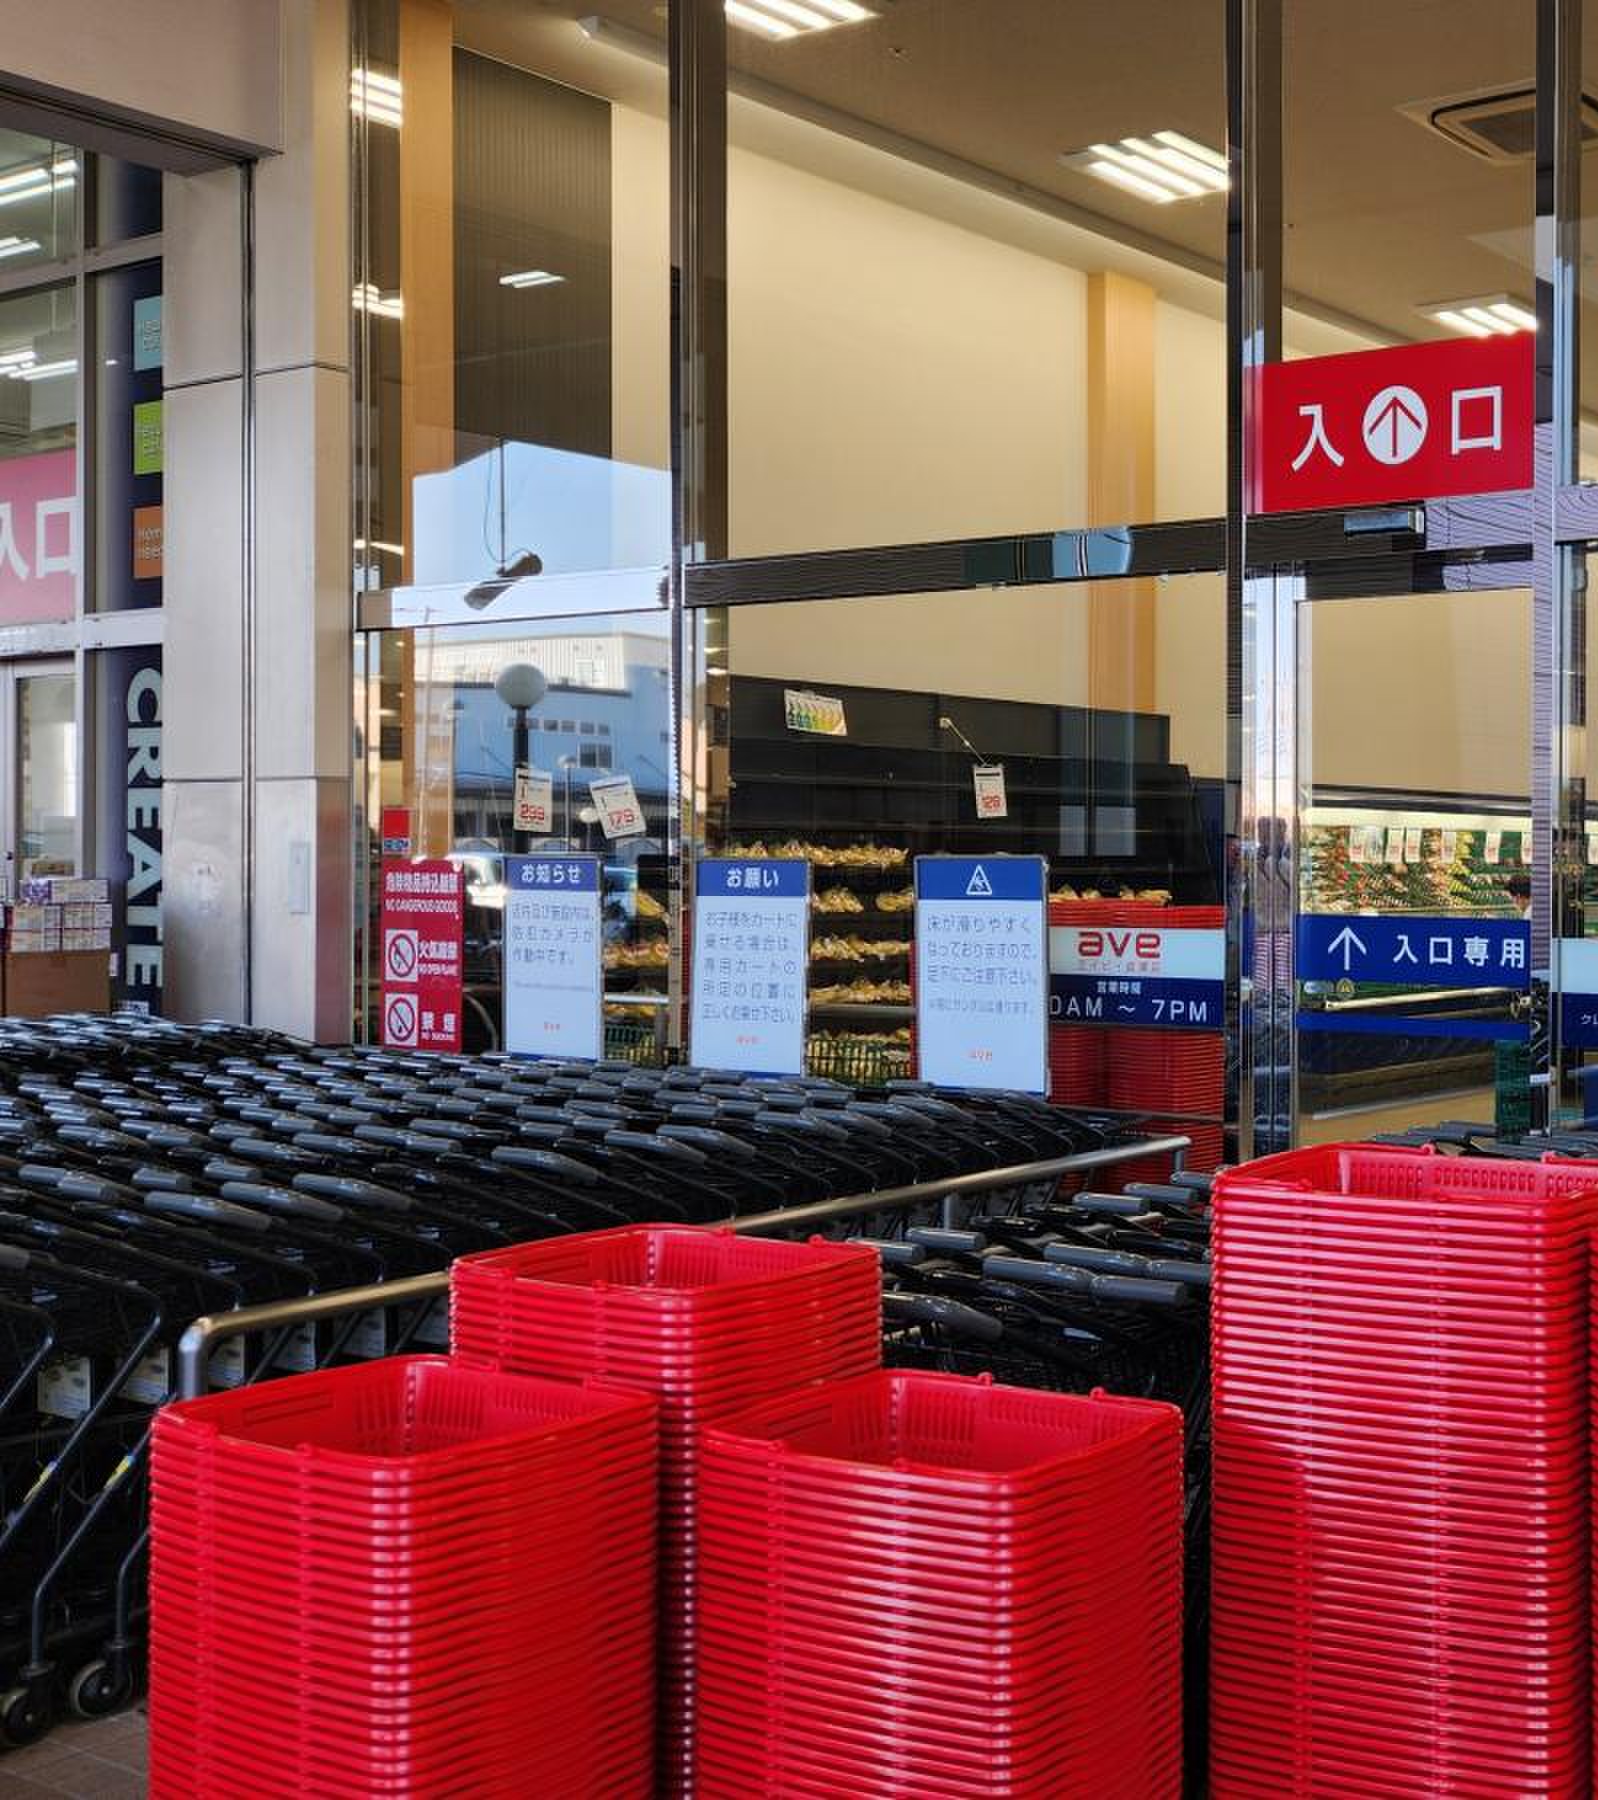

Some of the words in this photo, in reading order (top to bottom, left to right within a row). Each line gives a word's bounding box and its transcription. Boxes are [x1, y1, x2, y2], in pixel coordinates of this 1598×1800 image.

[1291, 385, 1502, 472] 入口
[127, 668, 163, 987] CREATE
[521, 864, 582, 884] お知らせ
[726, 866, 780, 889] お願い
[1077, 931, 1161, 959] ave
[1393, 934, 1526, 970] 入口専用
[1151, 999, 1207, 1022] 7PM
